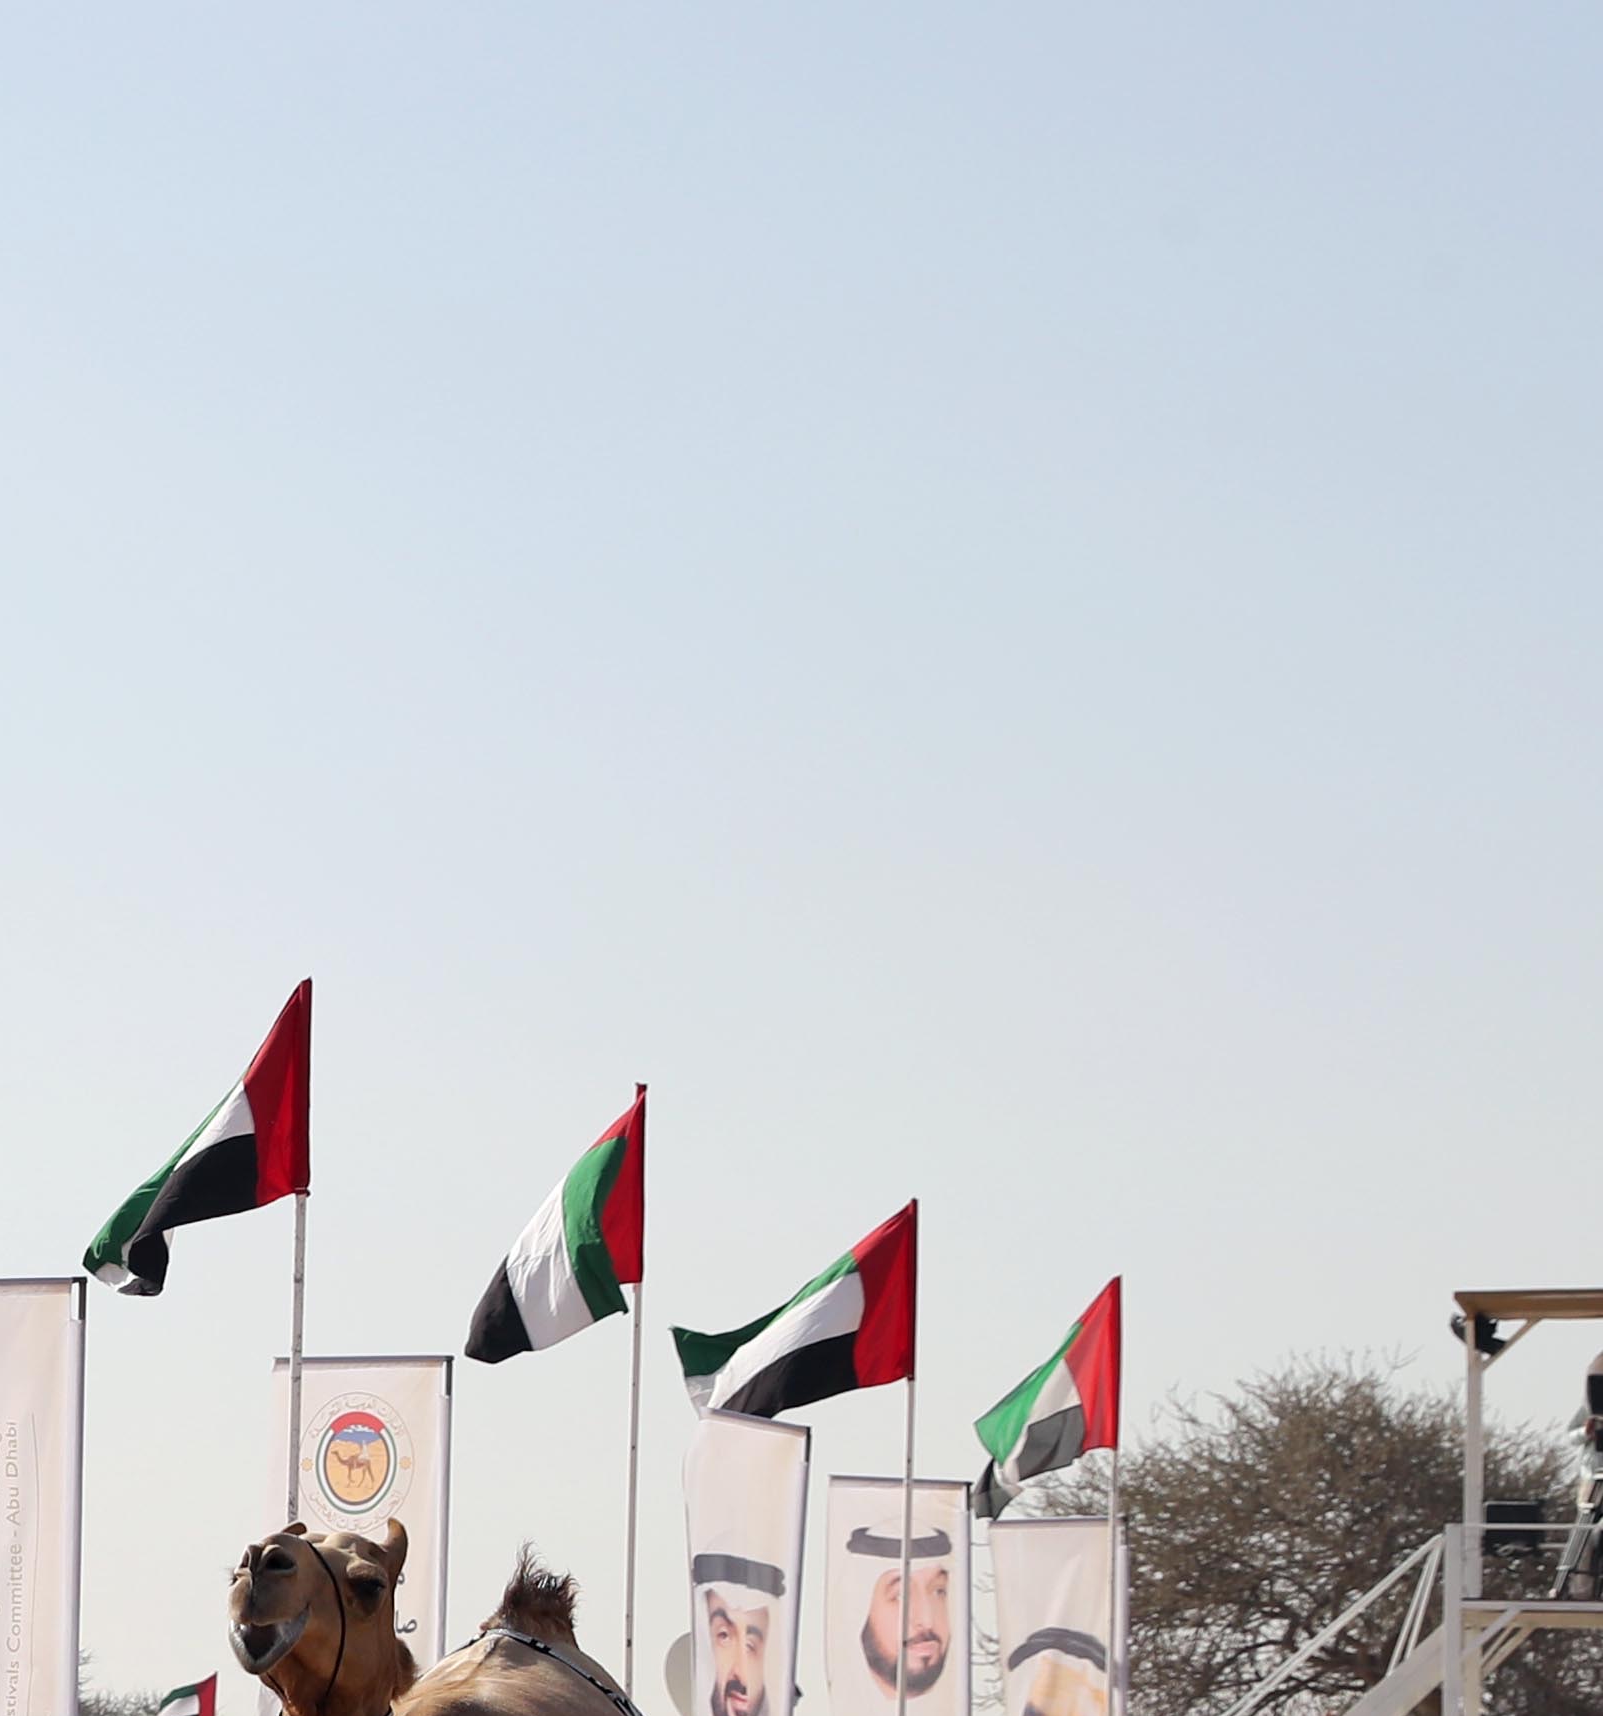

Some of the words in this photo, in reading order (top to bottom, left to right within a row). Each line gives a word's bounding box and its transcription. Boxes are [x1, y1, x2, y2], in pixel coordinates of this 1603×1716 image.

[5, 1421, 19, 1477] Dhabi
[5, 1487, 20, 1526] Abu
[6, 1544, 23, 1653] Committee
